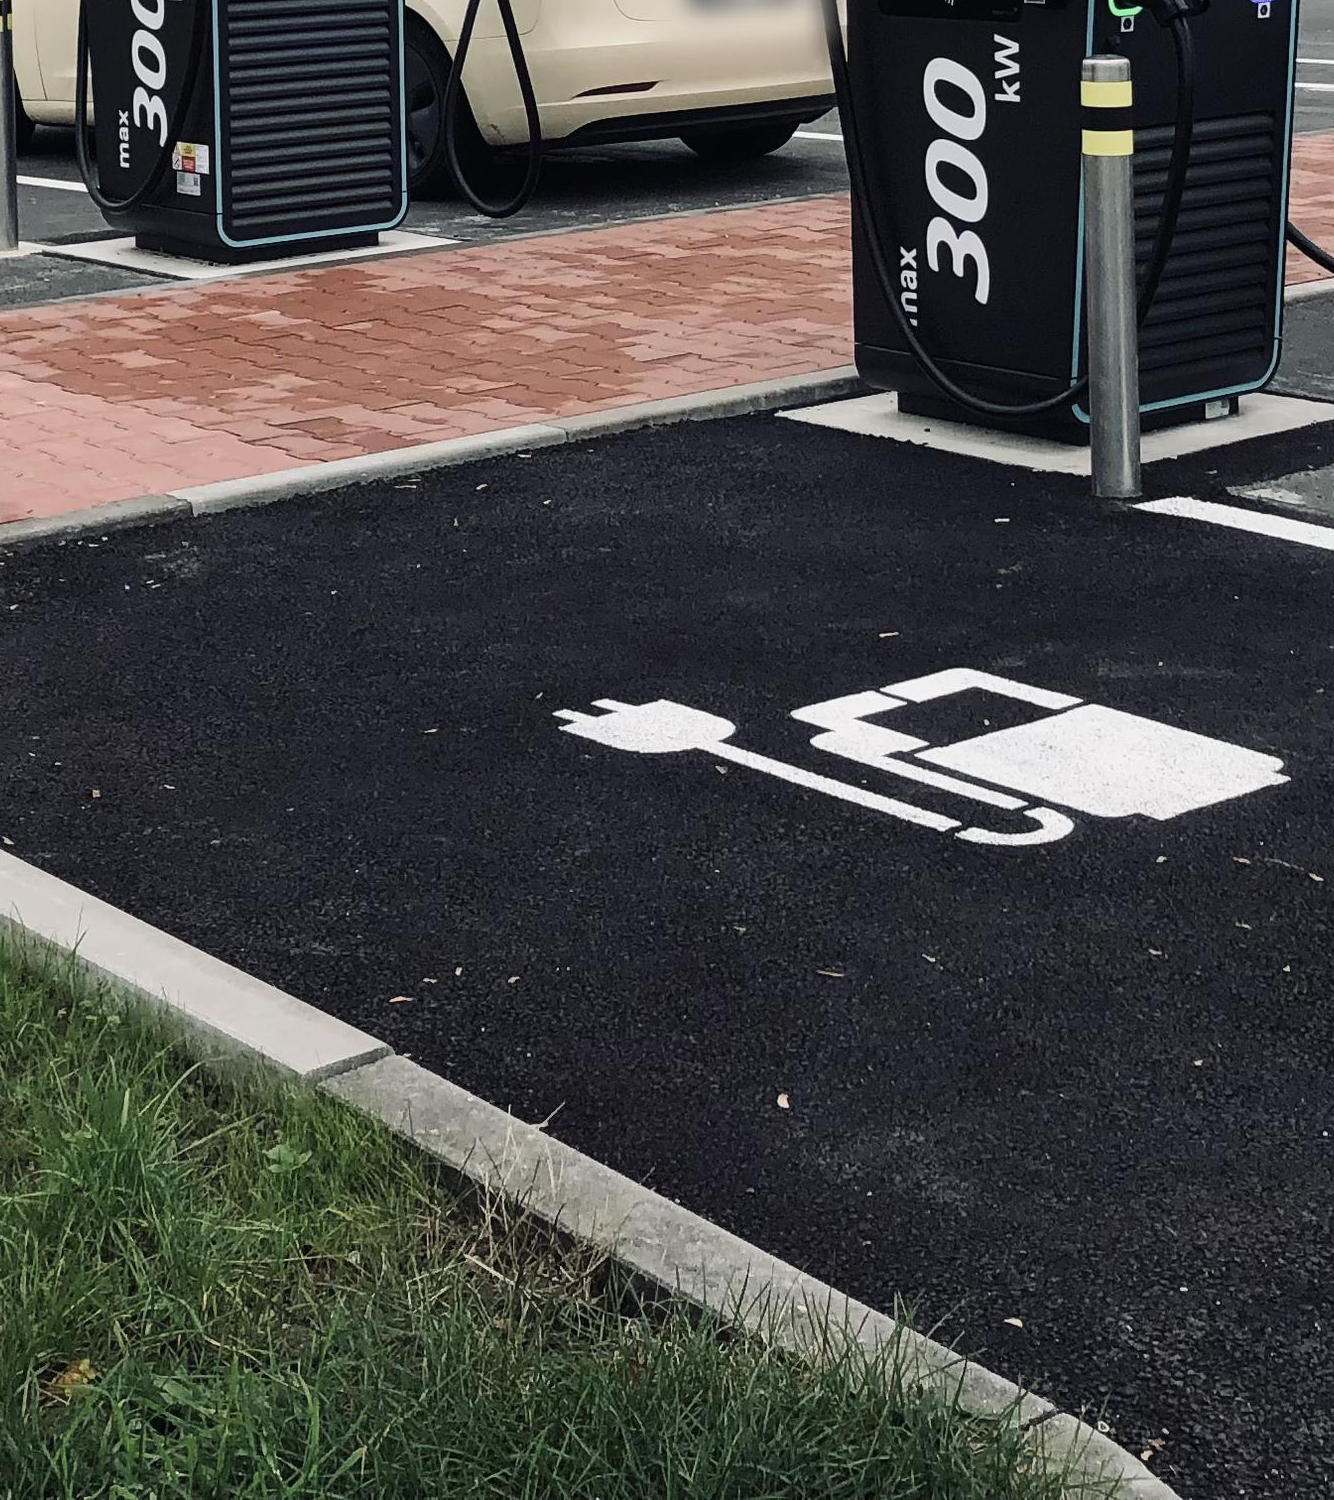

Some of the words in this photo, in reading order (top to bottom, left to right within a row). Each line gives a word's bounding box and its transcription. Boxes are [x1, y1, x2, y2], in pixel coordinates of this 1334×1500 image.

[993, 34, 1021, 103] kW
[118, 109, 131, 169] max
[922, 56, 991, 306] 300
